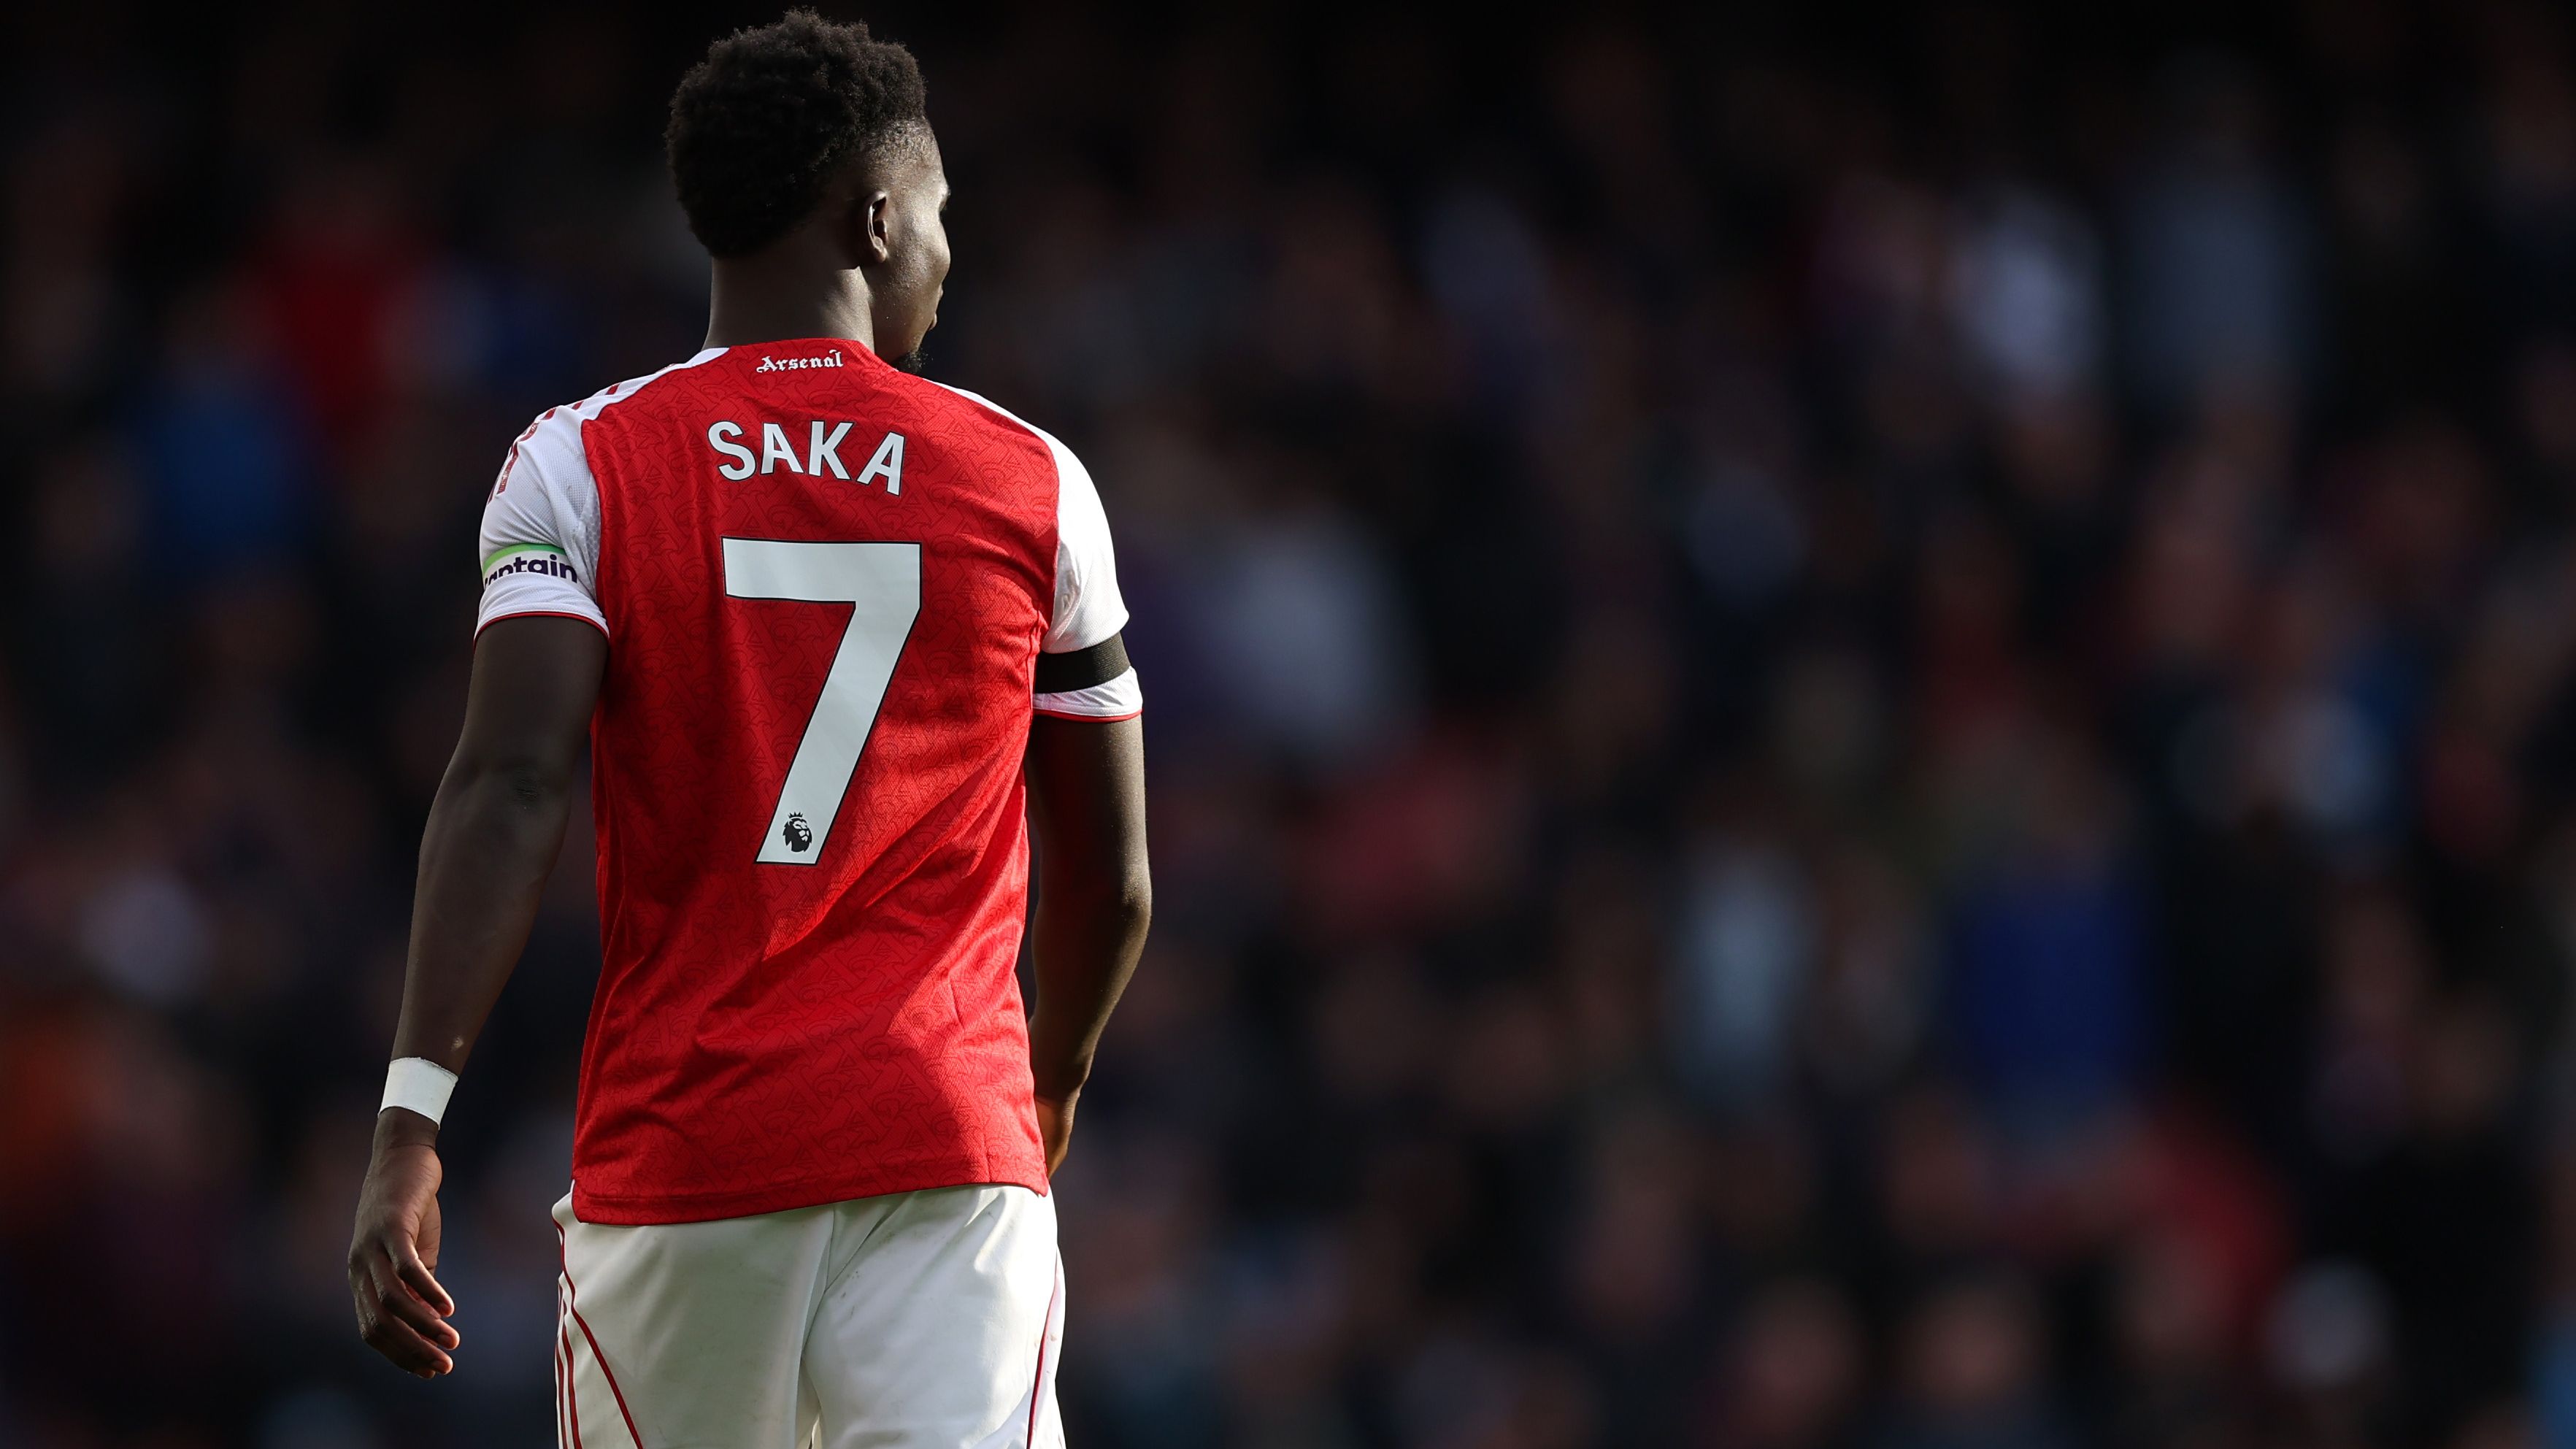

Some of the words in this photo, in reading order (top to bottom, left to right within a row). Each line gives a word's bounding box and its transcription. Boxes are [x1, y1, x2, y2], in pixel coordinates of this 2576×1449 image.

[756, 349, 844, 373] Arsenal
[707, 420, 906, 496] SAKA
[485, 553, 578, 587] tain
[720, 536, 922, 865] 7
